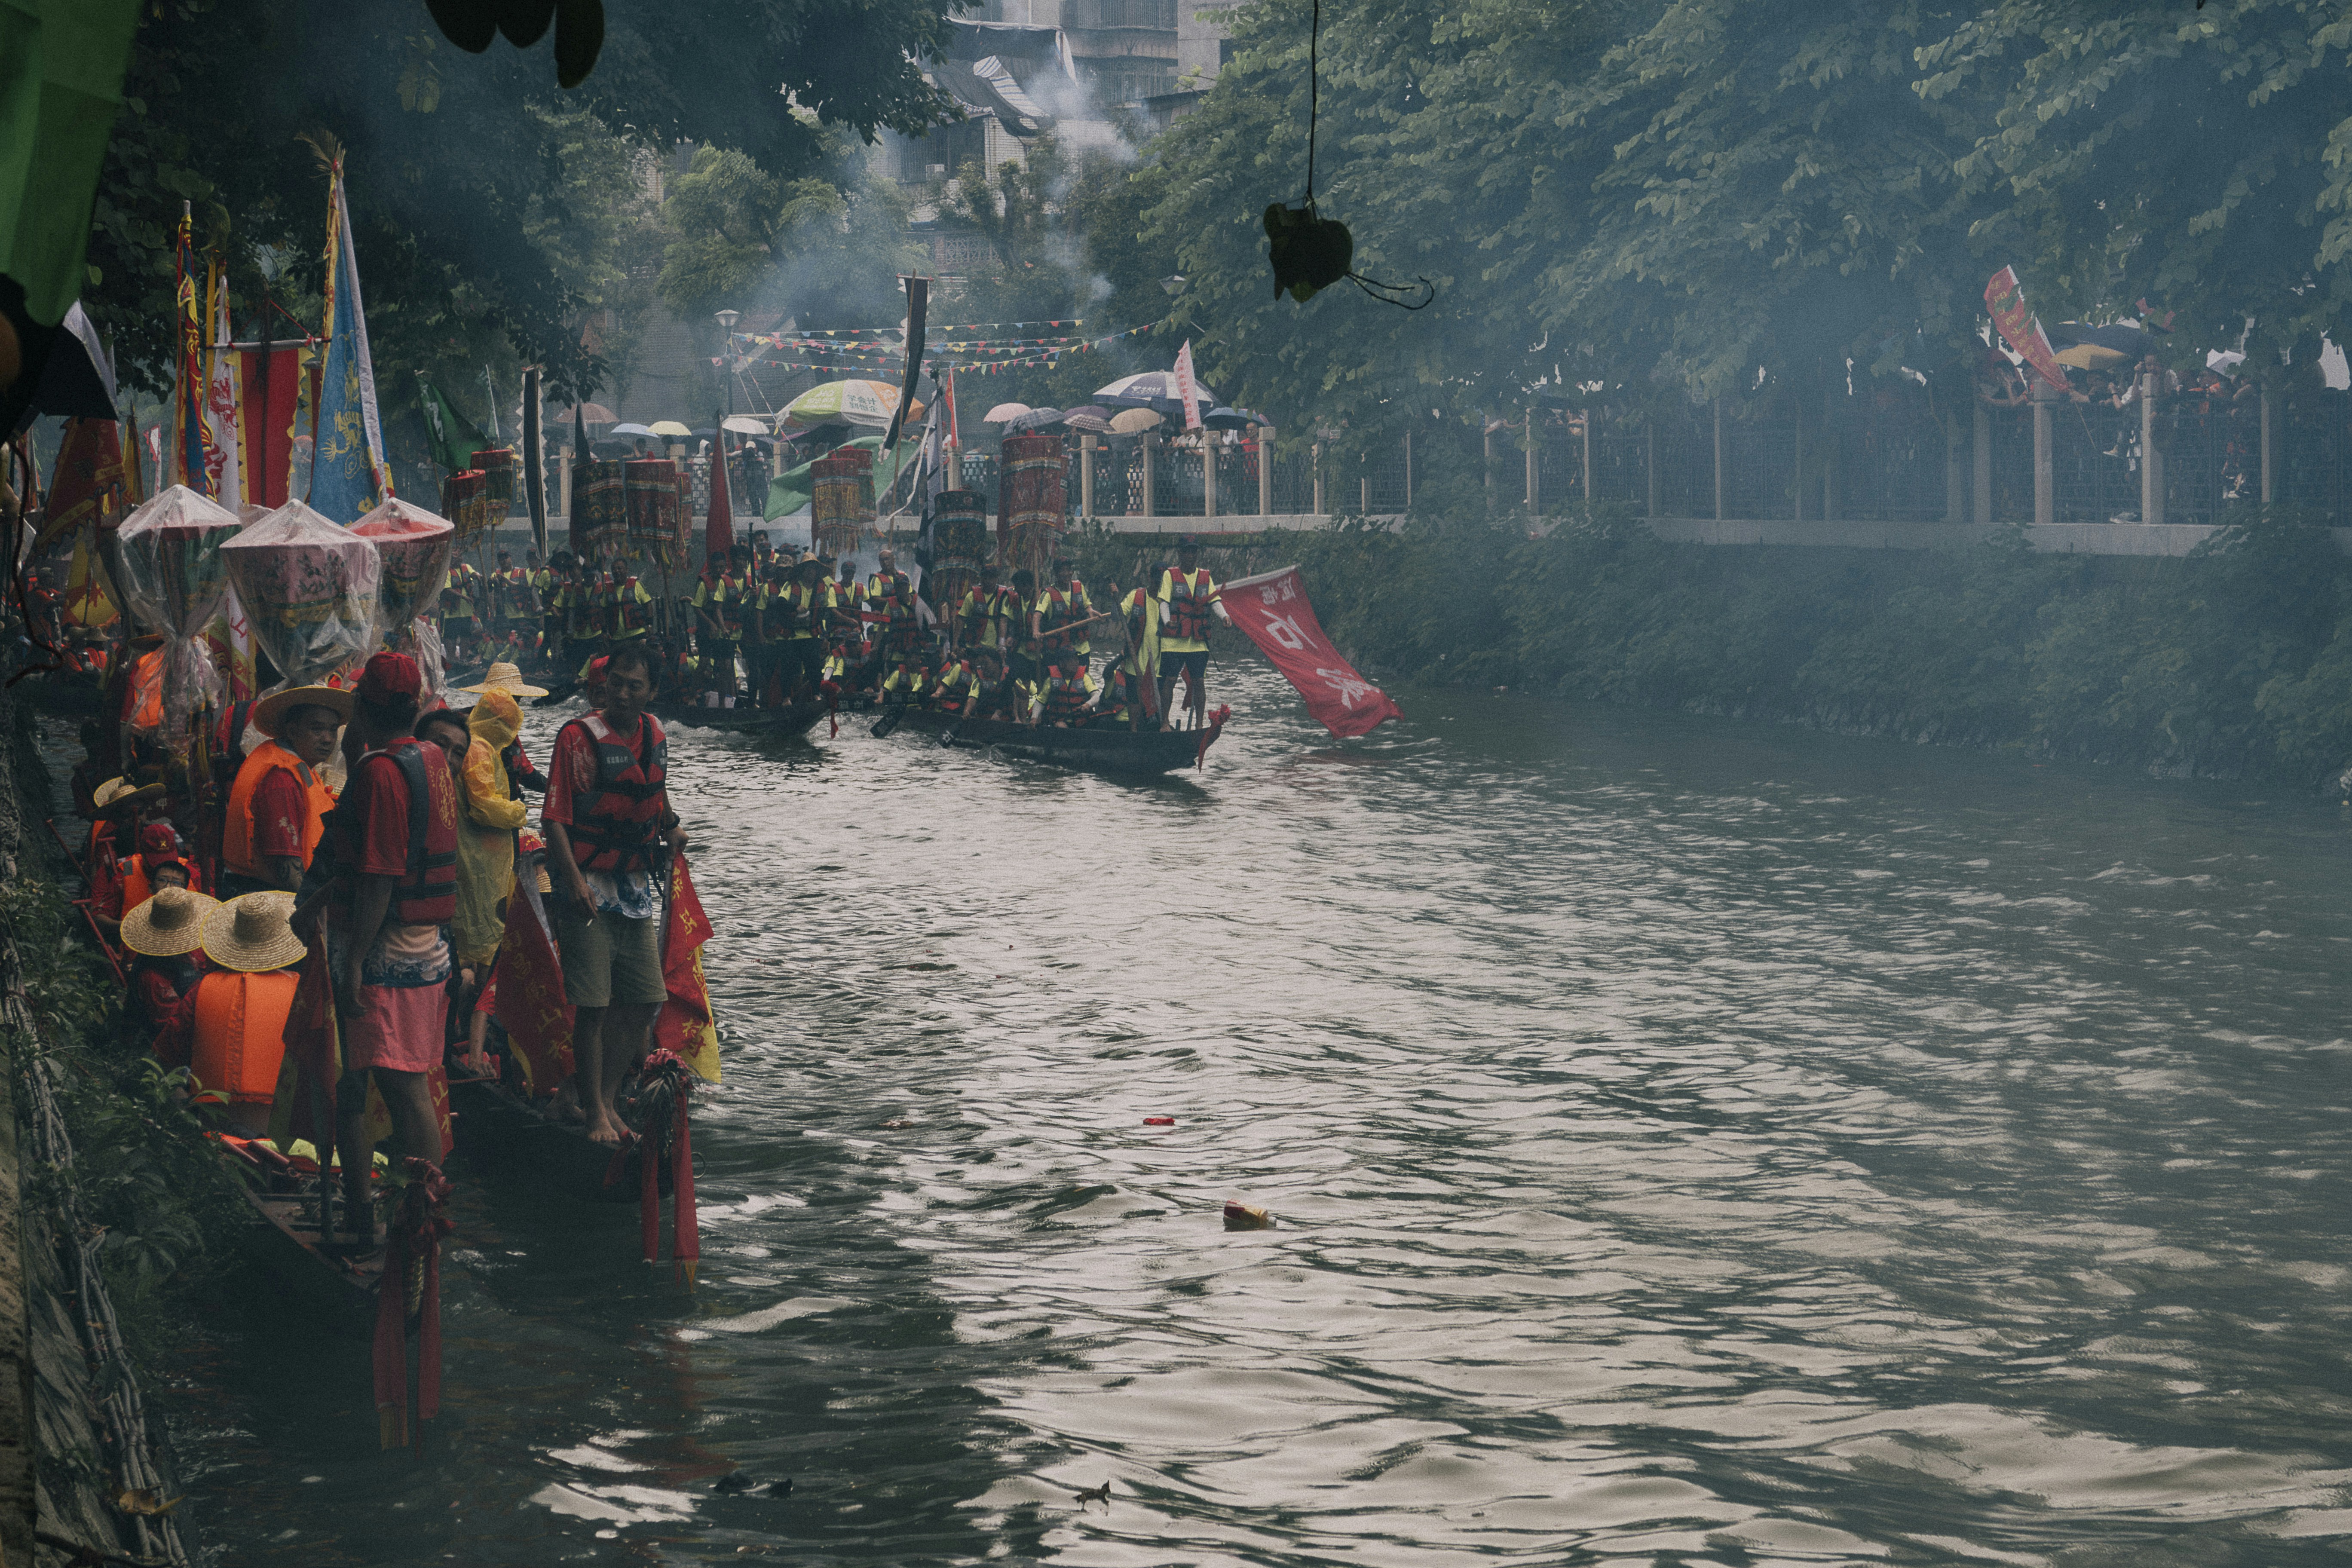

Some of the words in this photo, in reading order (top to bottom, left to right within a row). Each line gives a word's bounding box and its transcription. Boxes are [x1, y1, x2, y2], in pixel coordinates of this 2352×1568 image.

[848, 394, 876, 405] 学会计
[1176, 585, 1183, 593] 石
